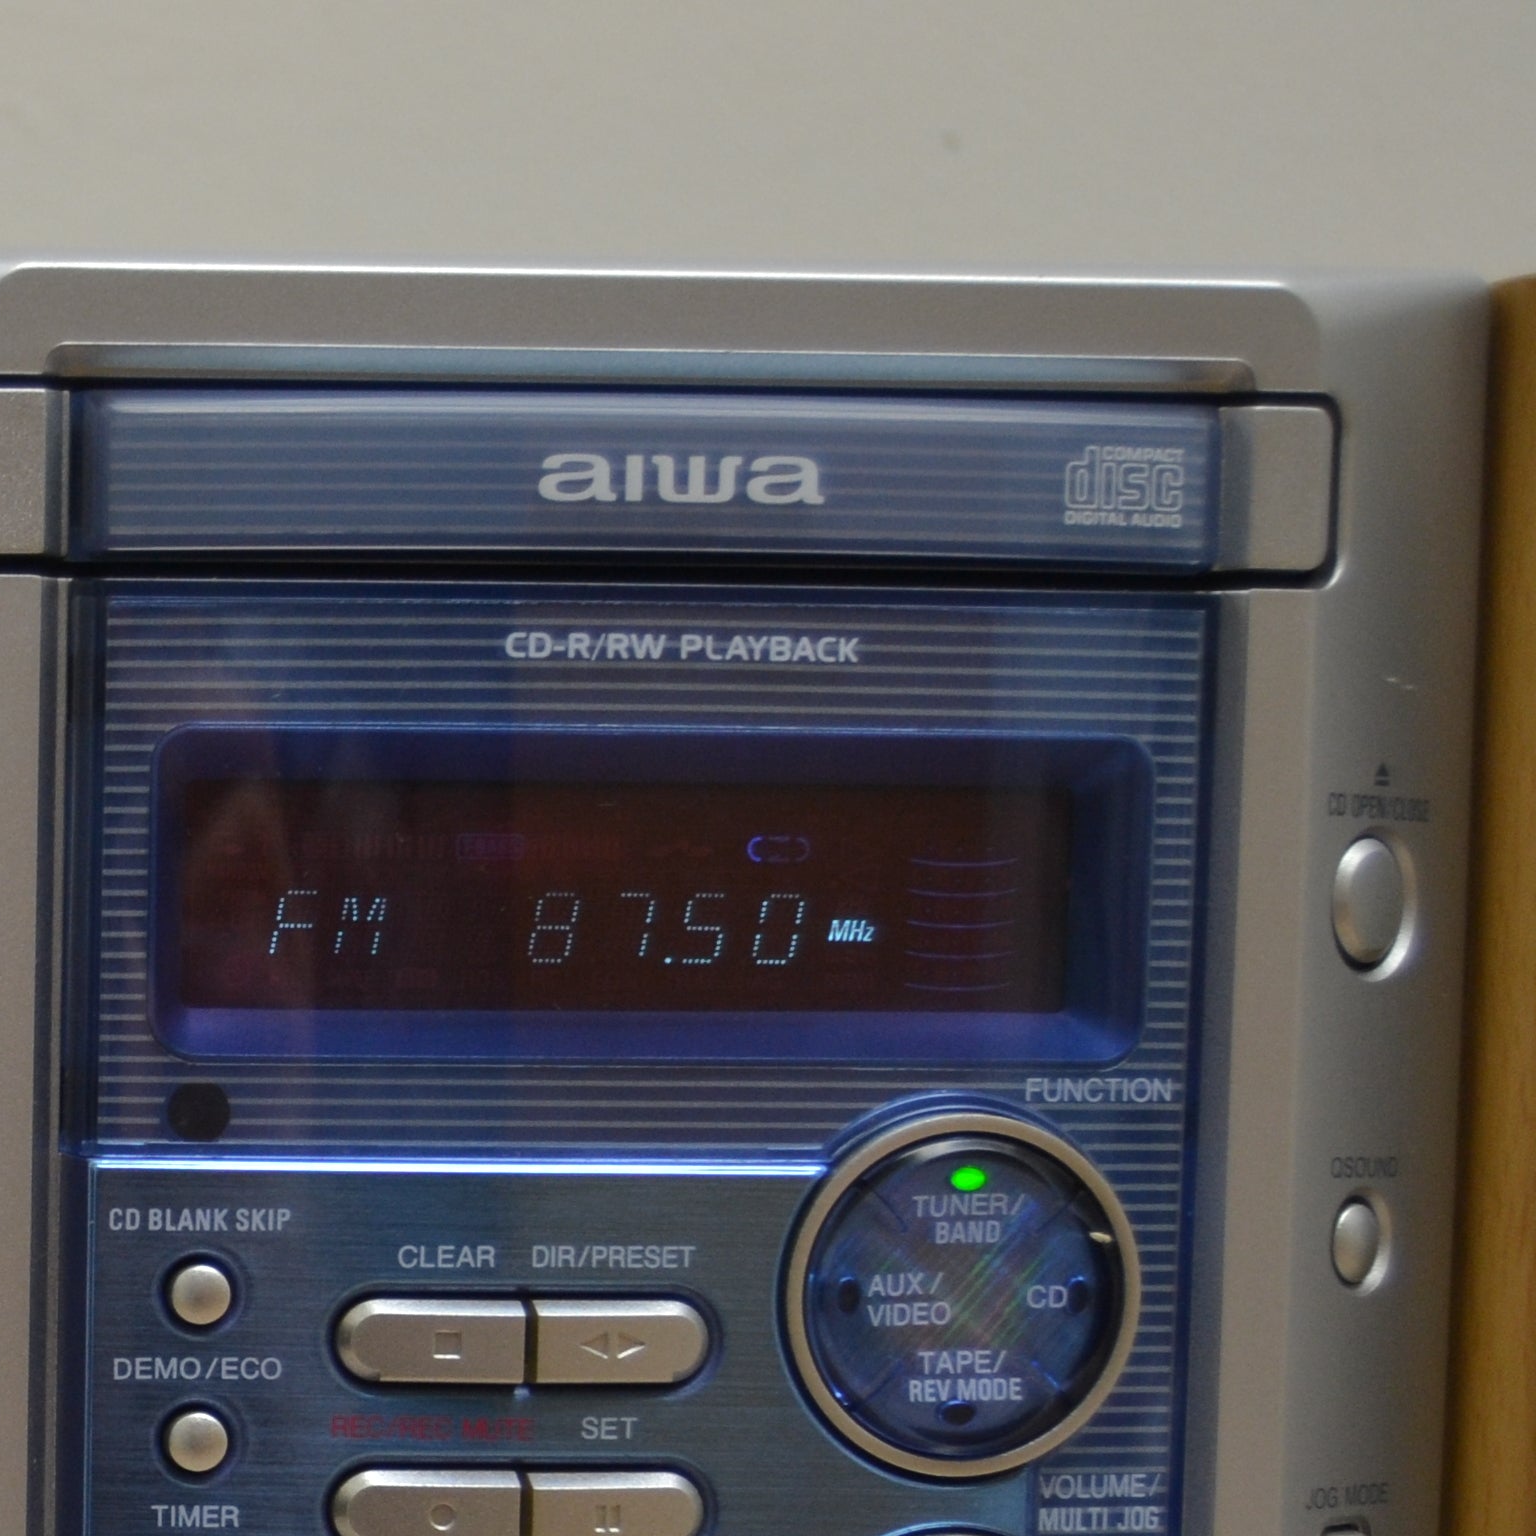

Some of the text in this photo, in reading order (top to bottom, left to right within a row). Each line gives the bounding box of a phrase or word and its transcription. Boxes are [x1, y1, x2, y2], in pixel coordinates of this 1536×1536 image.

[538, 452, 826, 506] aiwa
[1065, 445, 1184, 512] disc
[1064, 510, 1183, 529] DIGITAL AUDIO
[504, 631, 860, 663] CD-R/RW PLAYBACK
[268, 888, 875, 966] FM 87.50 MHz
[1024, 1076, 1174, 1103] FUNCTION
[912, 1192, 1026, 1218] TUNER/
[108, 1207, 292, 1233] CD BLANK SKIP
[934, 1220, 1001, 1245] BAND
[397, 1245, 496, 1269] CLEAR
[531, 1245, 696, 1270] DIR/PRESET
[867, 1272, 944, 1298] AUX/
[1027, 1284, 1068, 1309] CD
[867, 1301, 952, 1328] VIDEO
[112, 1356, 283, 1381] DEMO/ECO
[918, 1350, 1007, 1375] TAPE/
[909, 1377, 1023, 1402] REV MODE
[461, 1415, 536, 1443] MUTE
[579, 1415, 639, 1440] SET
[1040, 1472, 1163, 1500] VOLUME/
[150, 1504, 241, 1529] TIMER
[1037, 1506, 1160, 1533] MULTI JOG
